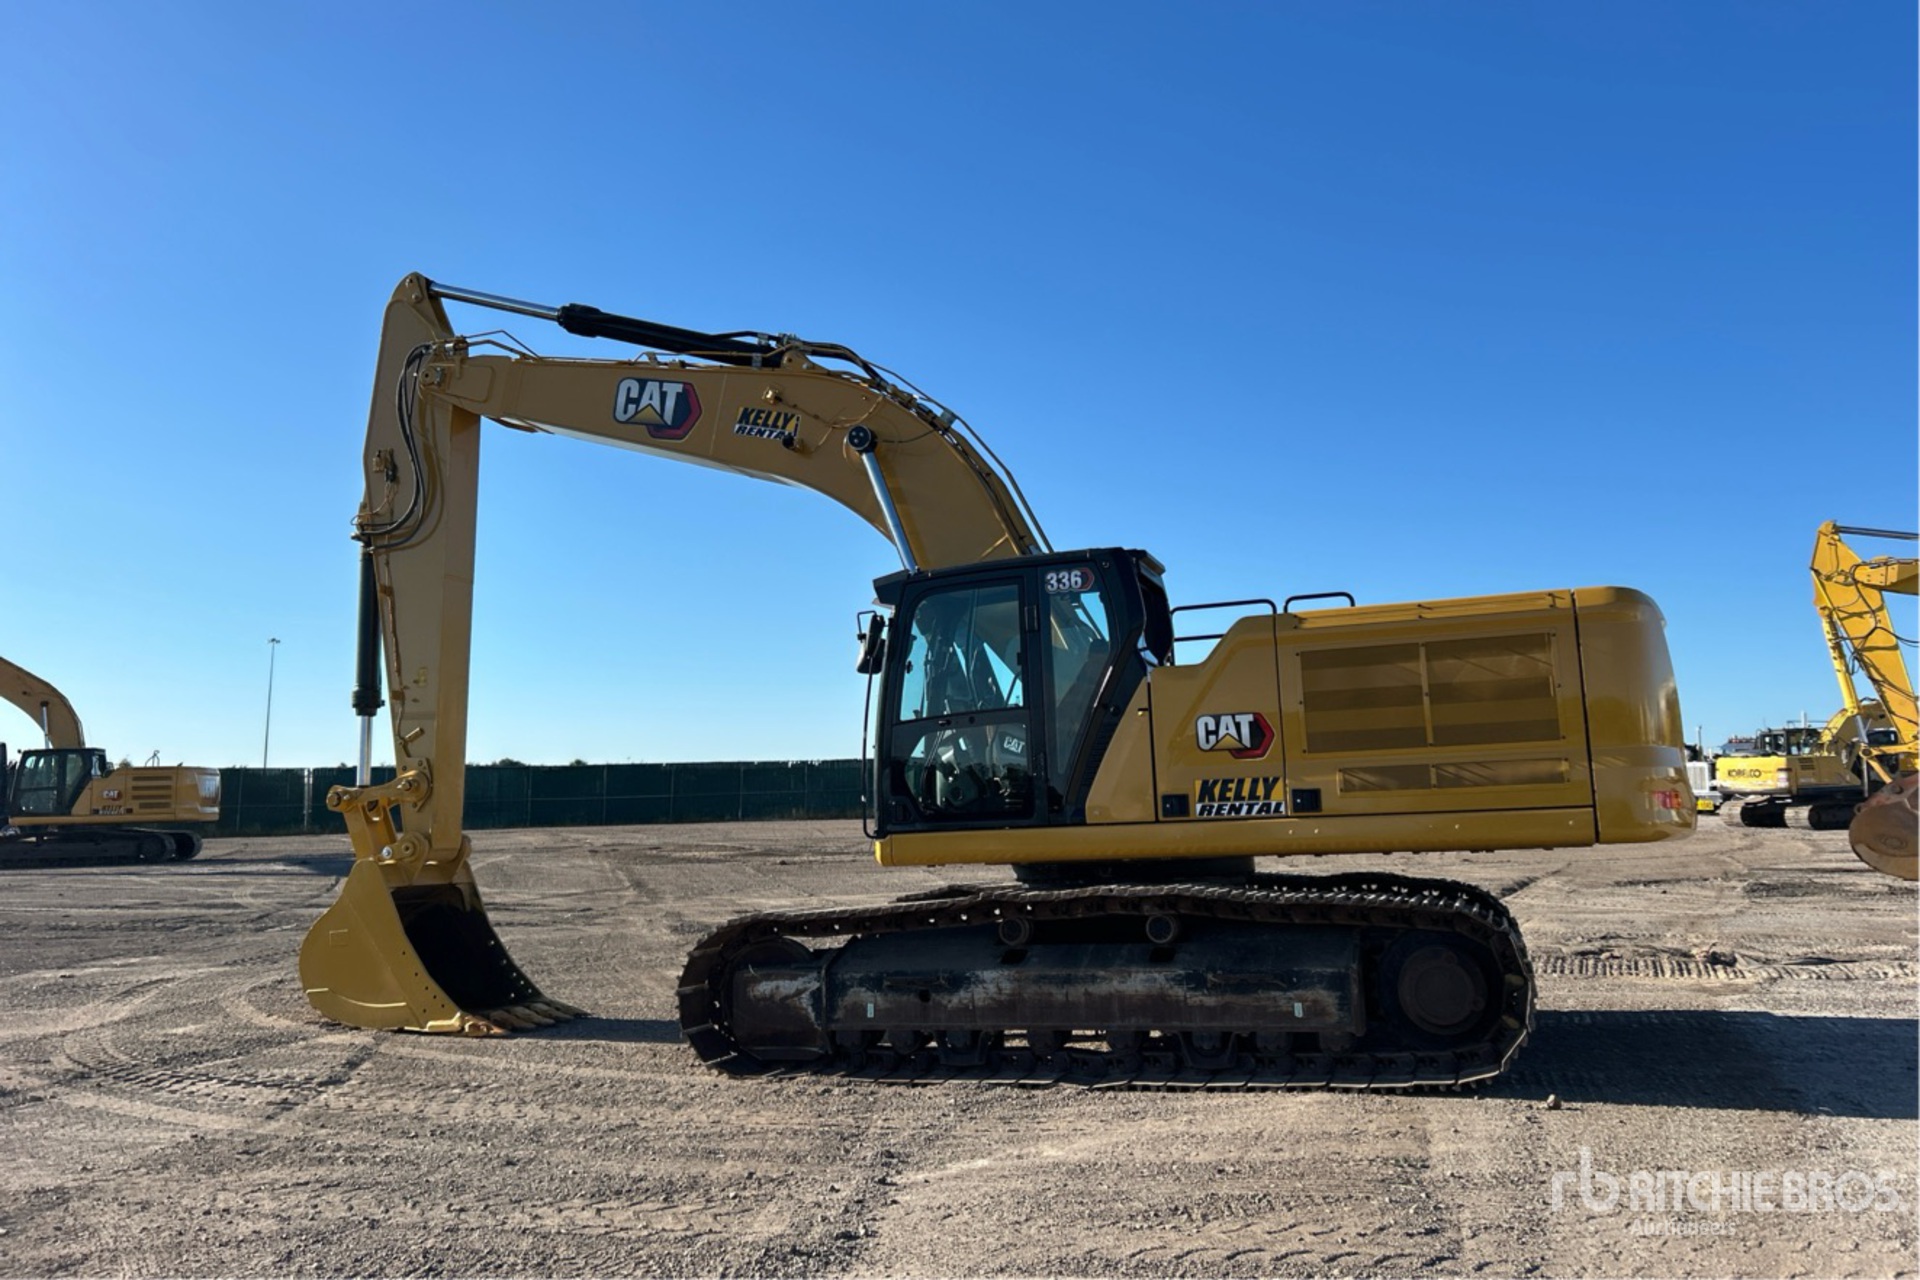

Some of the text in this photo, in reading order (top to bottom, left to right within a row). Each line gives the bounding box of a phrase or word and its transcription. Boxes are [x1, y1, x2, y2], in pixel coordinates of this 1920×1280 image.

[614, 378, 685, 426] CAT
[736, 407, 796, 430] KELLY
[734, 425, 795, 440] RENTA
[1046, 570, 1082, 591] 336
[1196, 713, 1255, 751] CAT
[1003, 736, 1026, 754] CAT
[1196, 776, 1281, 803] KELLY
[1197, 801, 1285, 817] RENTAL
